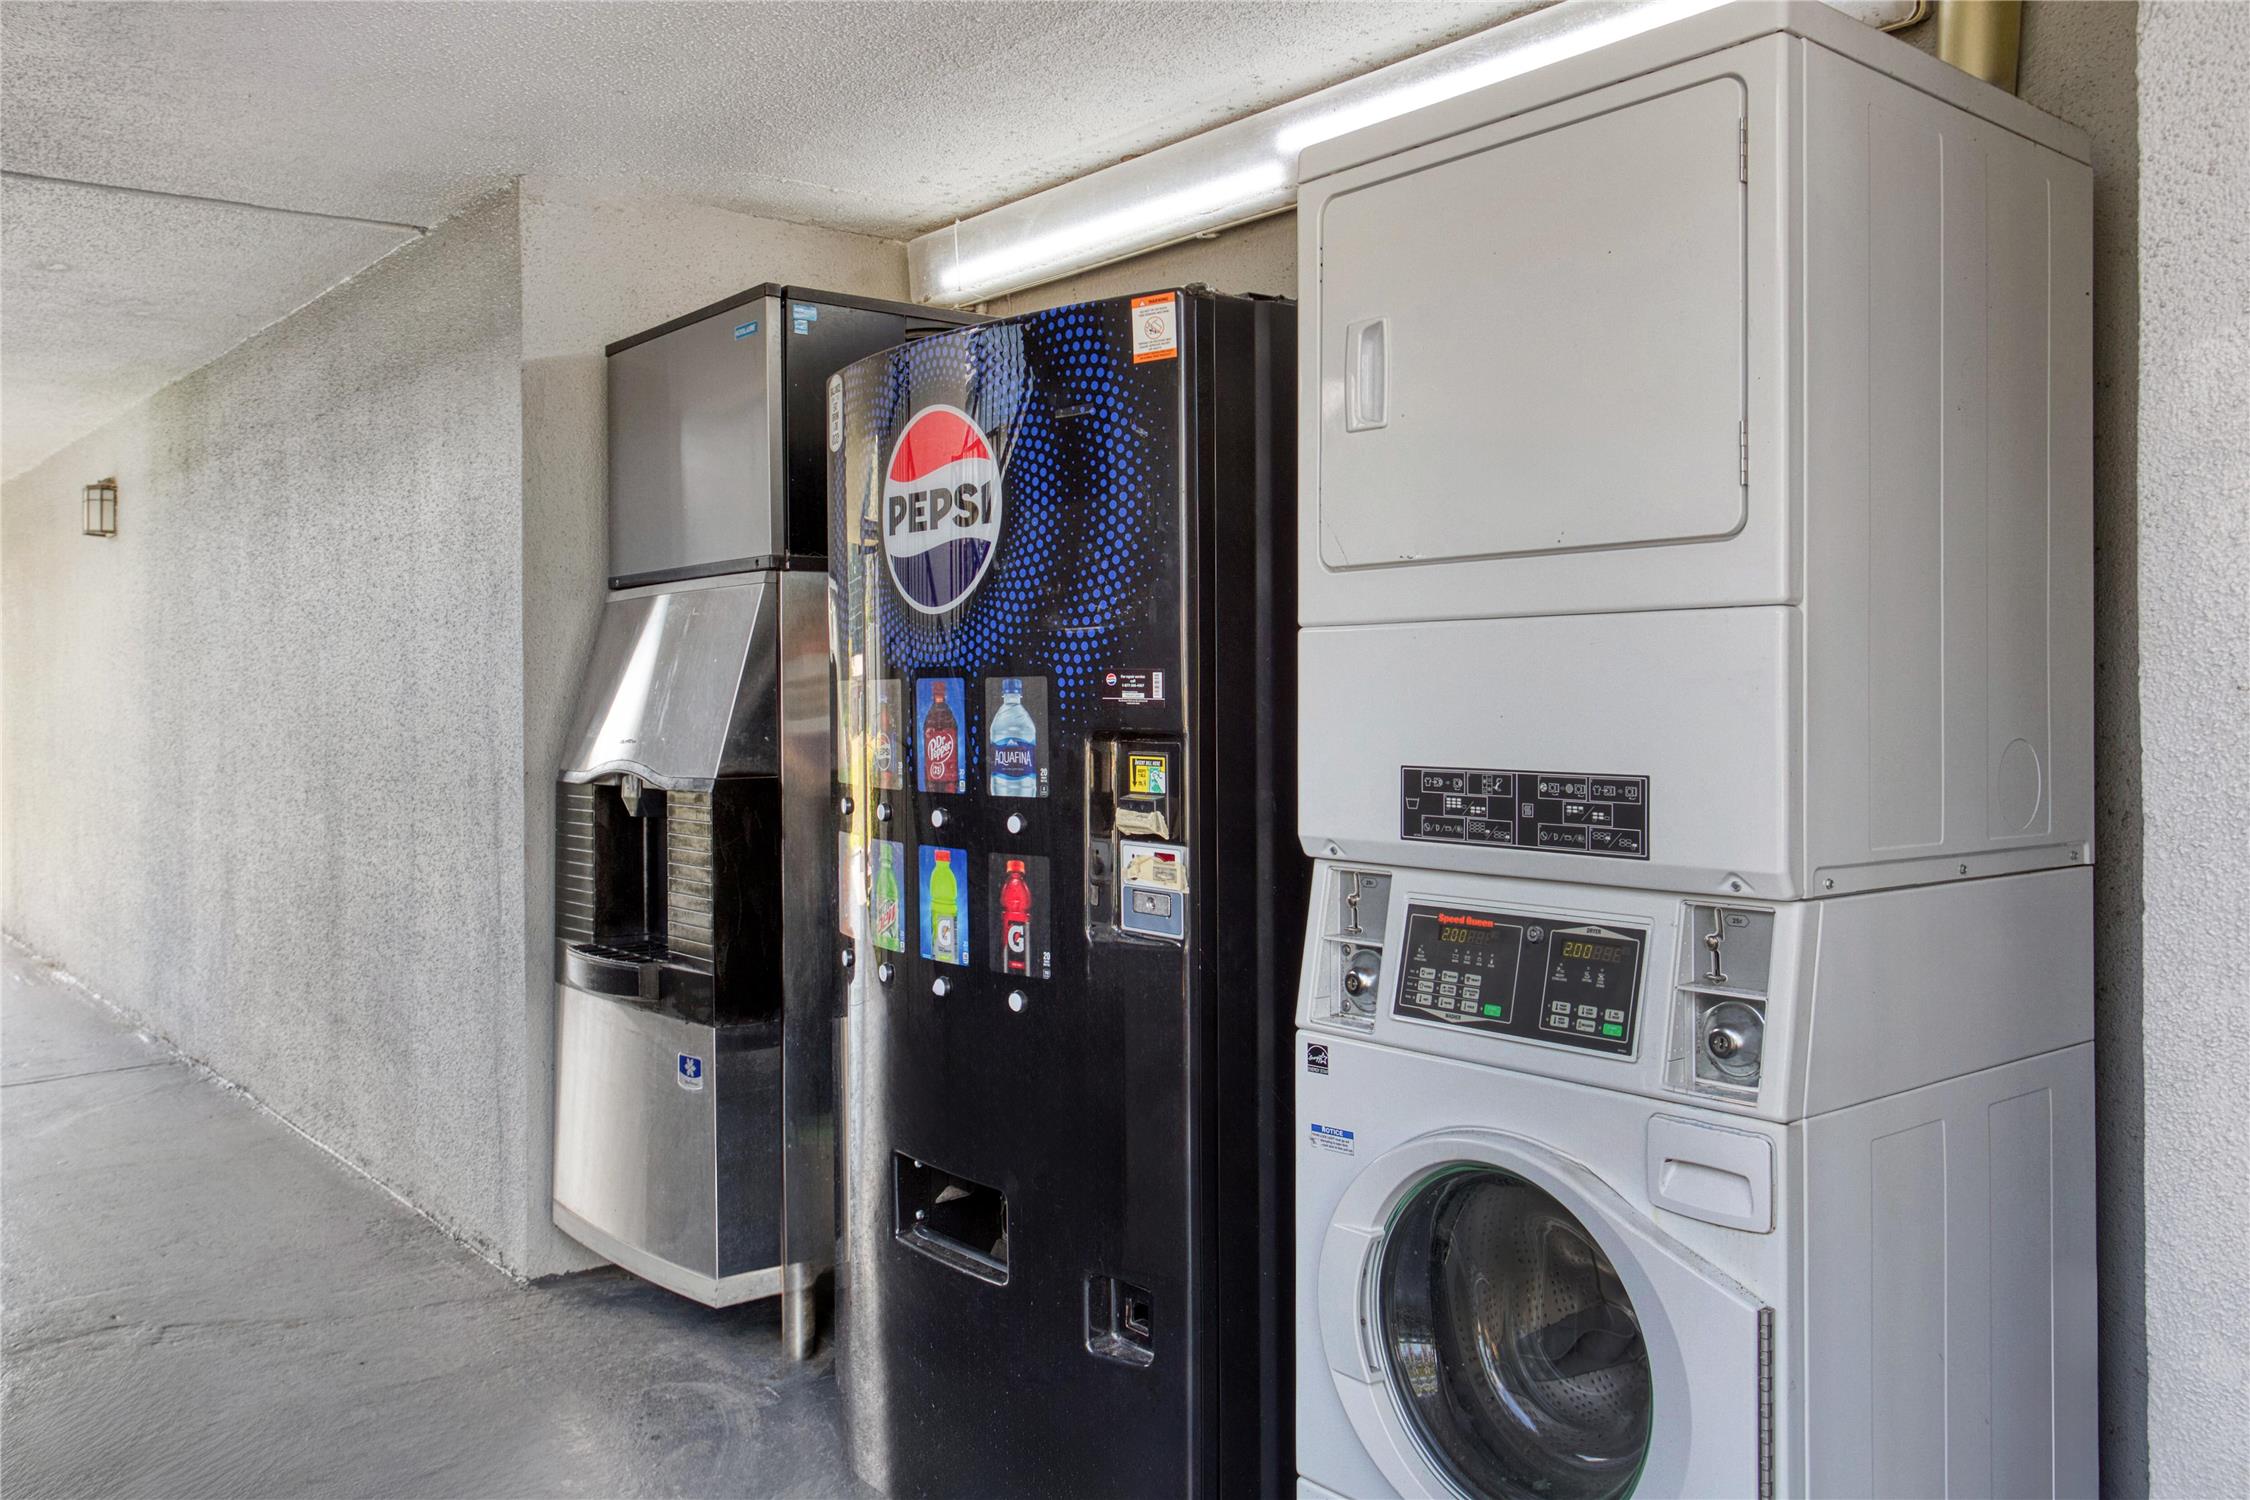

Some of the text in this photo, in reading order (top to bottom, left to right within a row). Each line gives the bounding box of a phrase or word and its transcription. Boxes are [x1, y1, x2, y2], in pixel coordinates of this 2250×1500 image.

[889, 480, 992, 536] PEPSI
[994, 750, 1033, 767] AQUAFINA
[1438, 913, 1495, 928] Speed Queen
[938, 919, 951, 946] G
[1008, 925, 1025, 953] G
[1586, 927, 1602, 935] DRYER
[1563, 941, 1593, 959] 2.00
[1321, 1126, 1344, 1137] NOTICE
